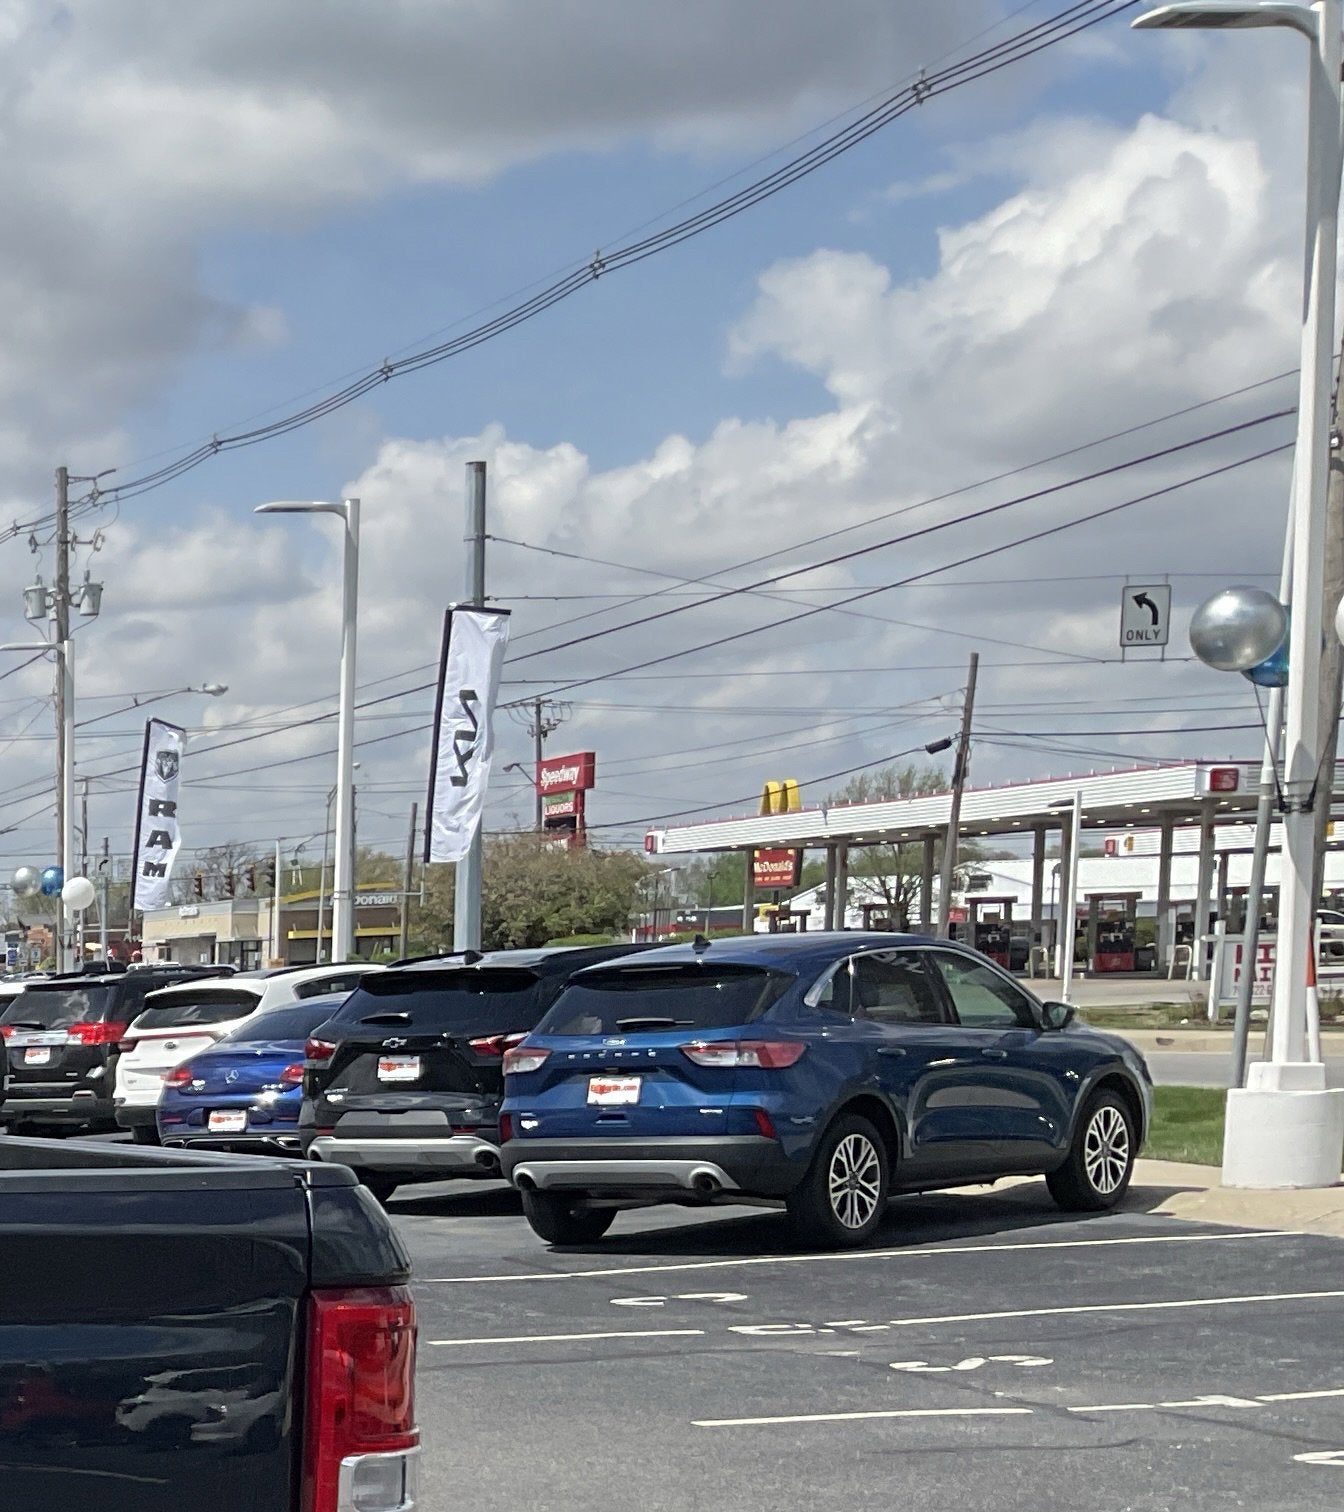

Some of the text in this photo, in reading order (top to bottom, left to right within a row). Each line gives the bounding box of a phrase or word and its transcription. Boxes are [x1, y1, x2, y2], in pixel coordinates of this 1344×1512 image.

[1125, 628, 1161, 641] ONLY
[540, 764, 580, 791] Speedway
[142, 798, 177, 878] RAM
